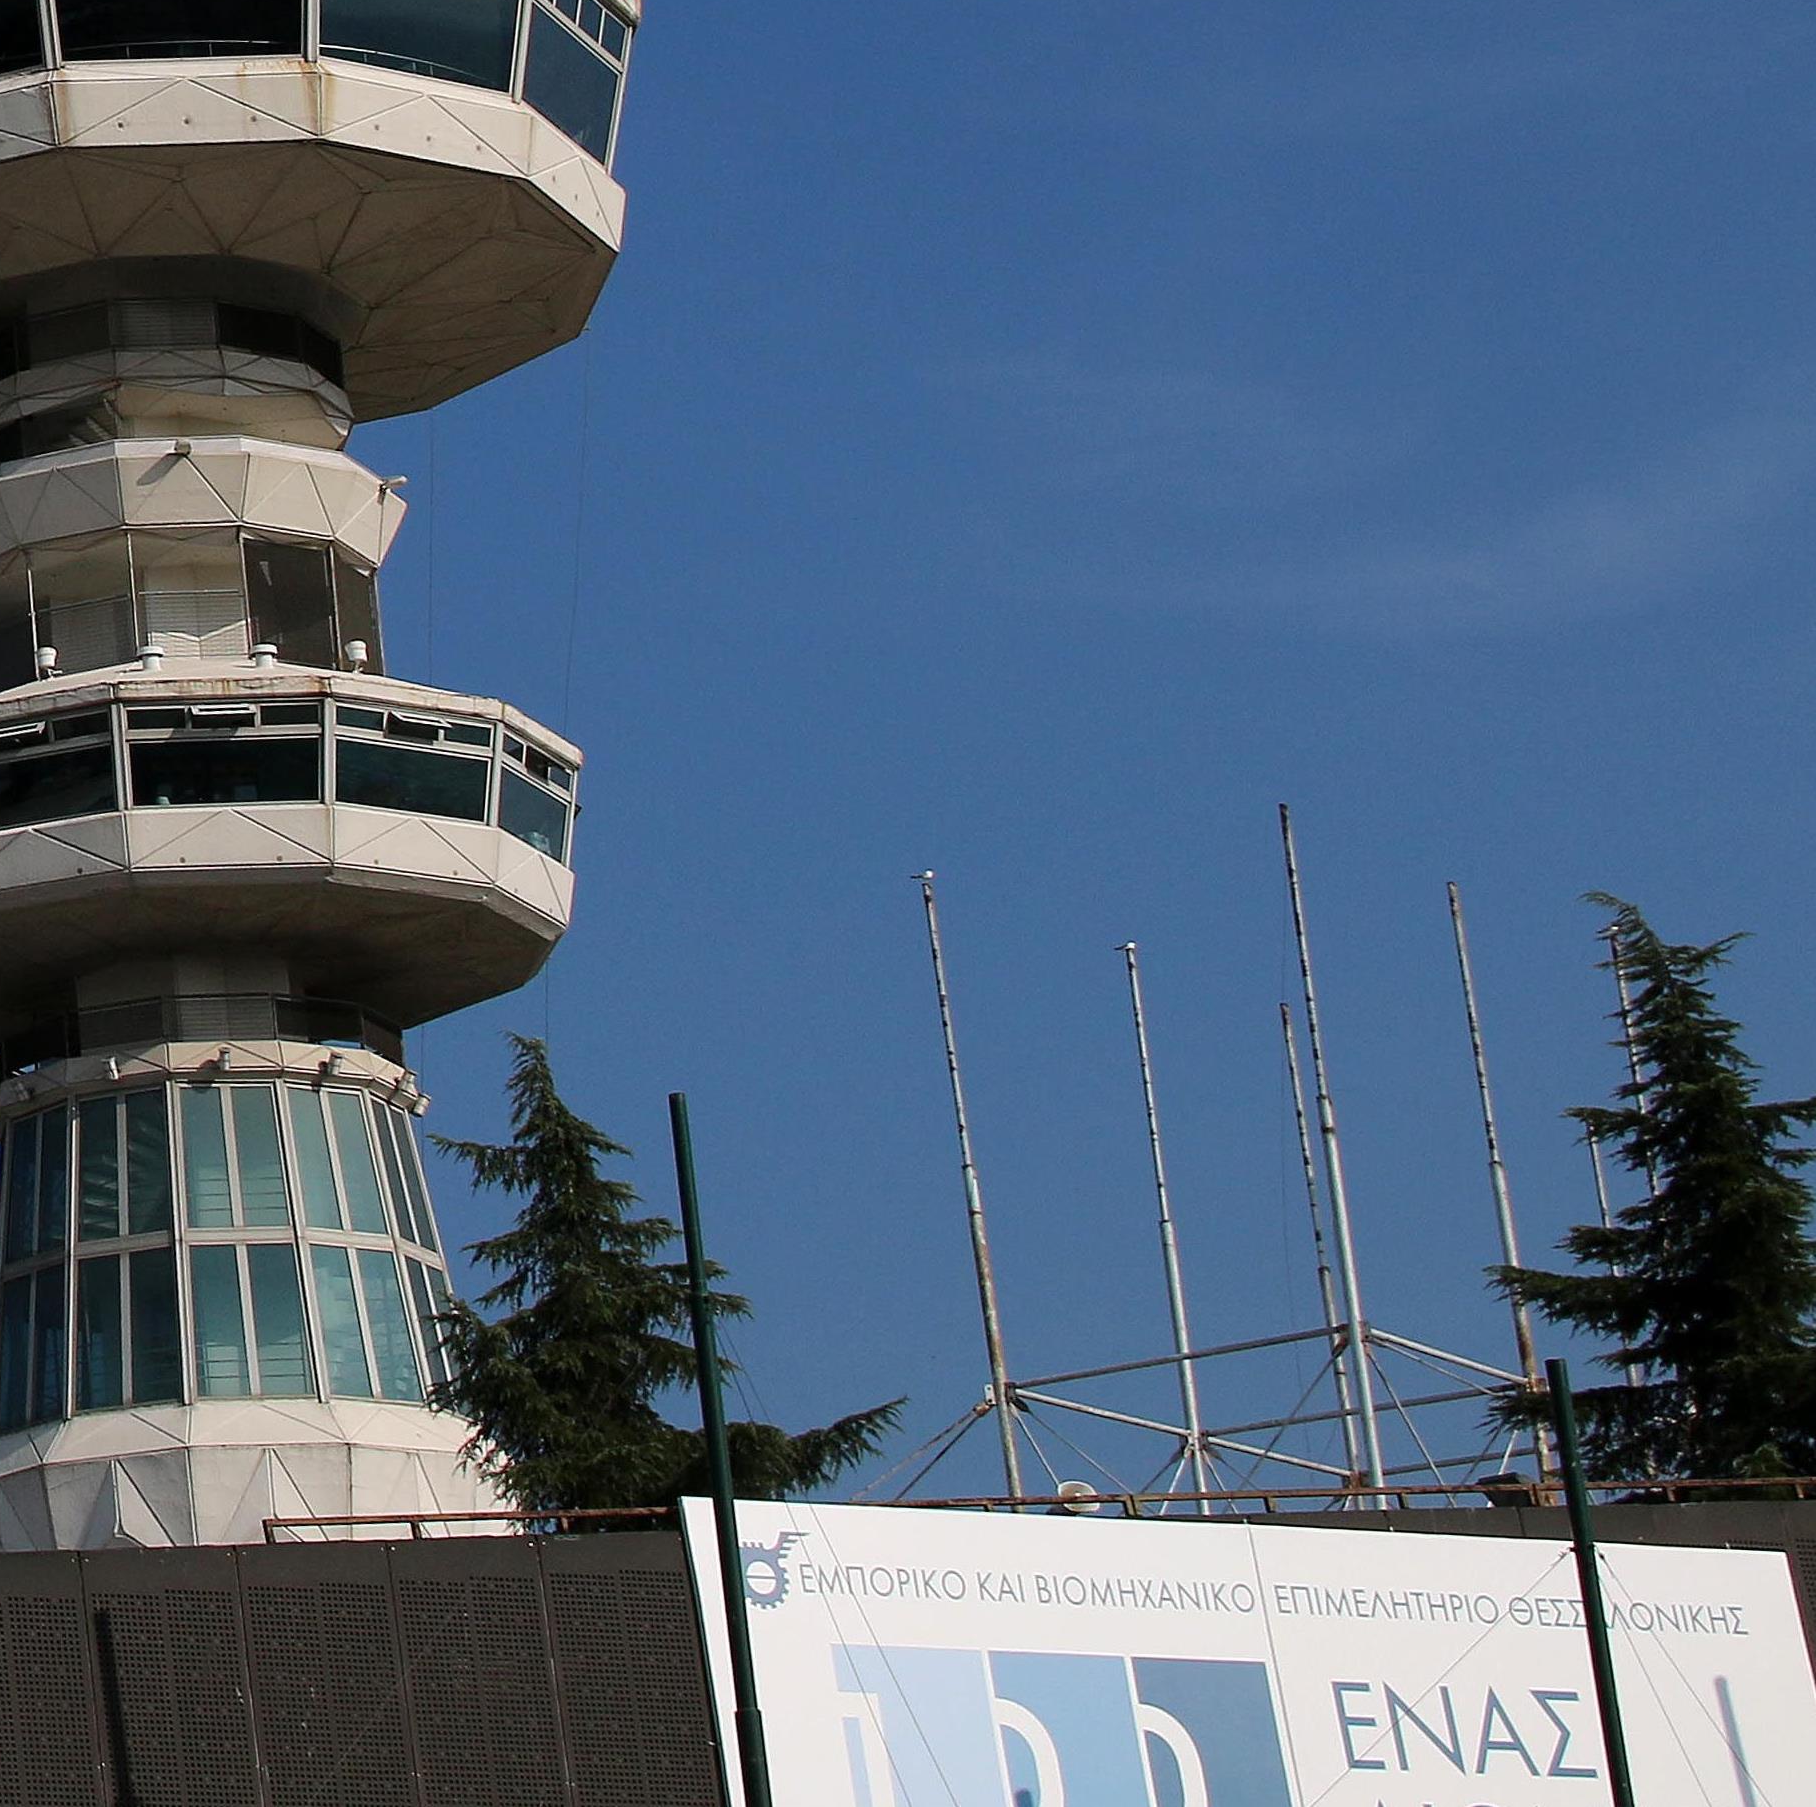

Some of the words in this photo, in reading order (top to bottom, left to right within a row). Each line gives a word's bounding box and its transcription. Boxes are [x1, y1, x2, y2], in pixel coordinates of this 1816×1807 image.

[798, 1564, 967, 1600] ΕΜΠΟΡΙΚΟ
[976, 1571, 1027, 1603] ΚΑΙ
[1035, 1575, 1255, 1614] ΒΙΟΜΗΧΑΝΙΚΟ
[1273, 1584, 1500, 1625] ΕΠΙΜΕΛΗΤΗΡΙΟ
[1508, 1597, 1750, 1636] ΘΕΣΣΛΟΝΙΚΗΣ
[1331, 1680, 1599, 1779] ΕΝΑΣ
